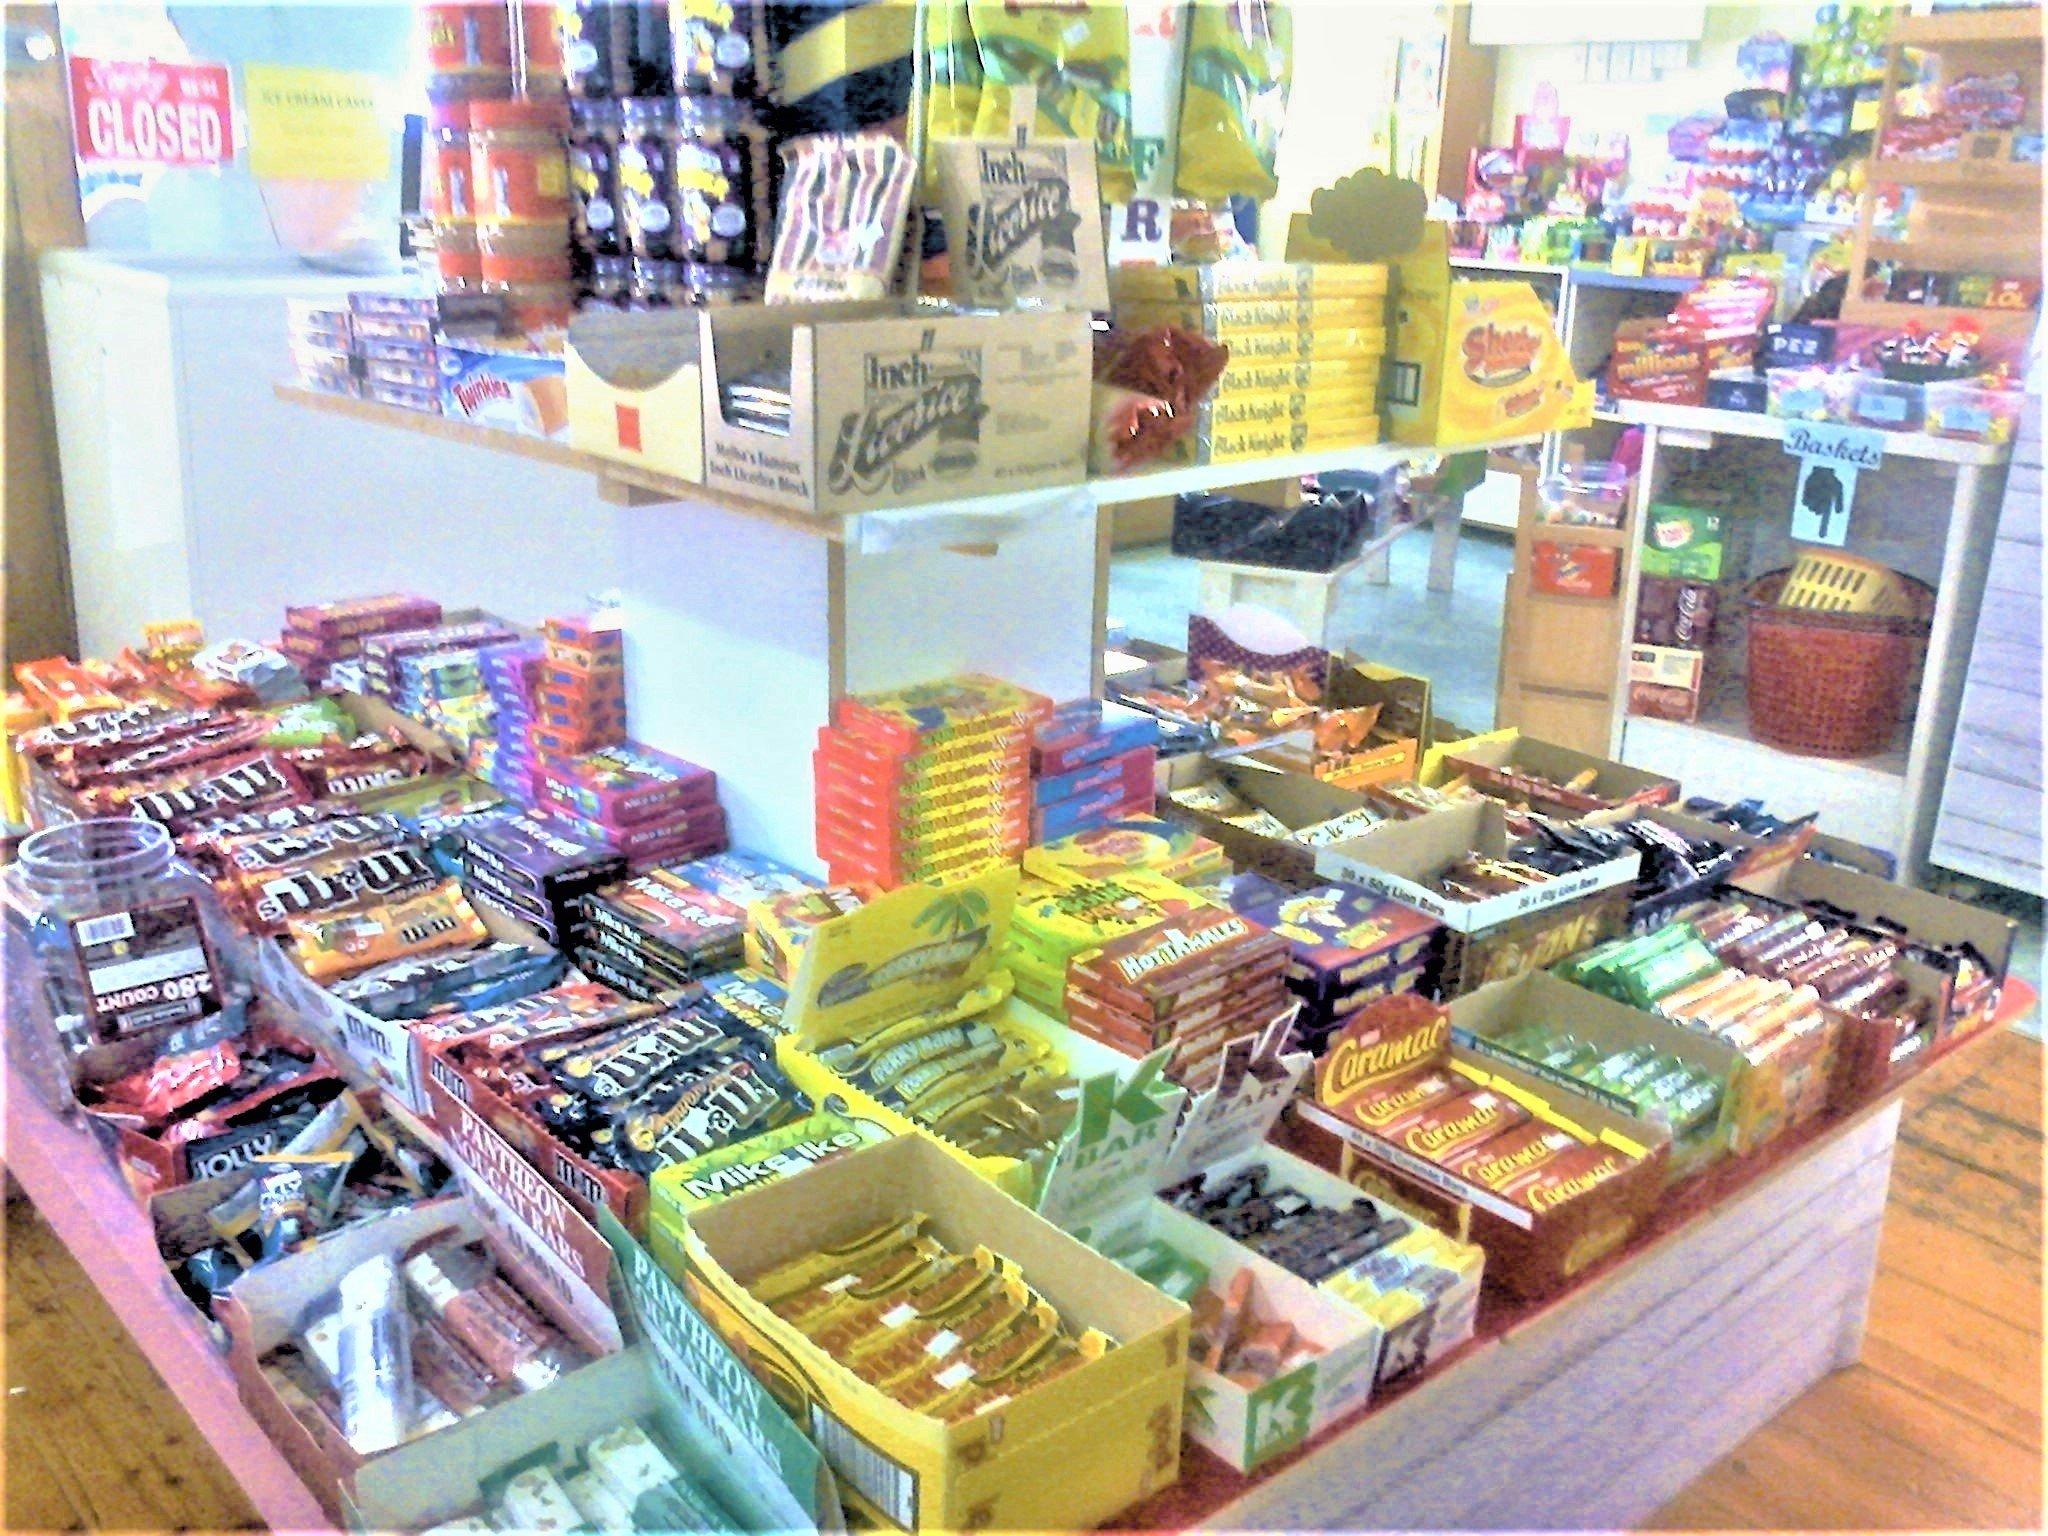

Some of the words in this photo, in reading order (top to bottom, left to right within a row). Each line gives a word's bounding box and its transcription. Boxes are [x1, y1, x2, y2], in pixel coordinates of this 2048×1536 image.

[87, 97, 223, 160] CLOSED
[979, 146, 1027, 185] Inch
[1120, 199, 1163, 244] R
[1773, 336, 1819, 356] PEZ
[867, 351, 933, 389] Inch
[453, 371, 511, 418] Twinkies
[1784, 429, 1880, 465] Baskets
[96, 985, 160, 1013] COUNT
[163, 973, 213, 1001] 280
[1323, 1014, 1448, 1107] Caramac
[194, 1132, 274, 1182] JOLLY
[460, 1109, 567, 1233] PANTHEON
[680, 1153, 790, 1200] Mike
[530, 1205, 586, 1279] BARS
[633, 1252, 763, 1420] PANTHEON
